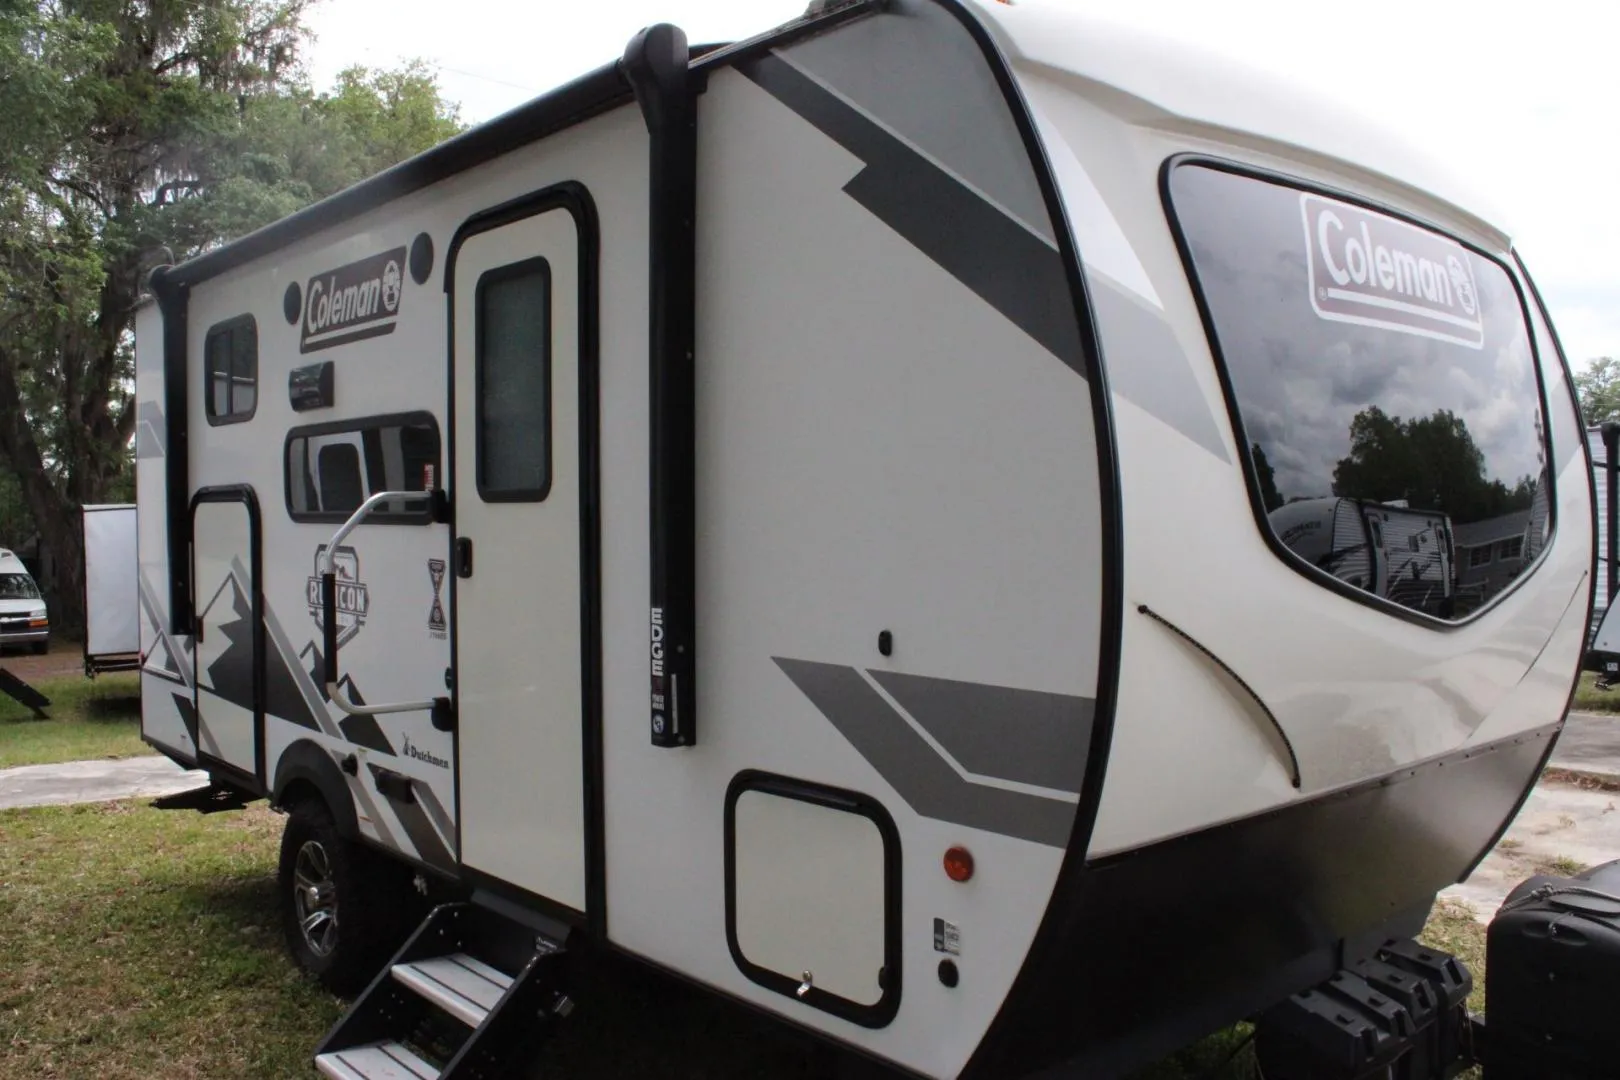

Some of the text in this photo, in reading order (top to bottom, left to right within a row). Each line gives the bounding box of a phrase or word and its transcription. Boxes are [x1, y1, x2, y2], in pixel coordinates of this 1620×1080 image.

[1318, 209, 1453, 307] Coleman
[307, 276, 381, 334] Coleman
[309, 581, 365, 612] RUICON
[651, 607, 664, 676] EDGE
[410, 745, 449, 769] Dutchmen
